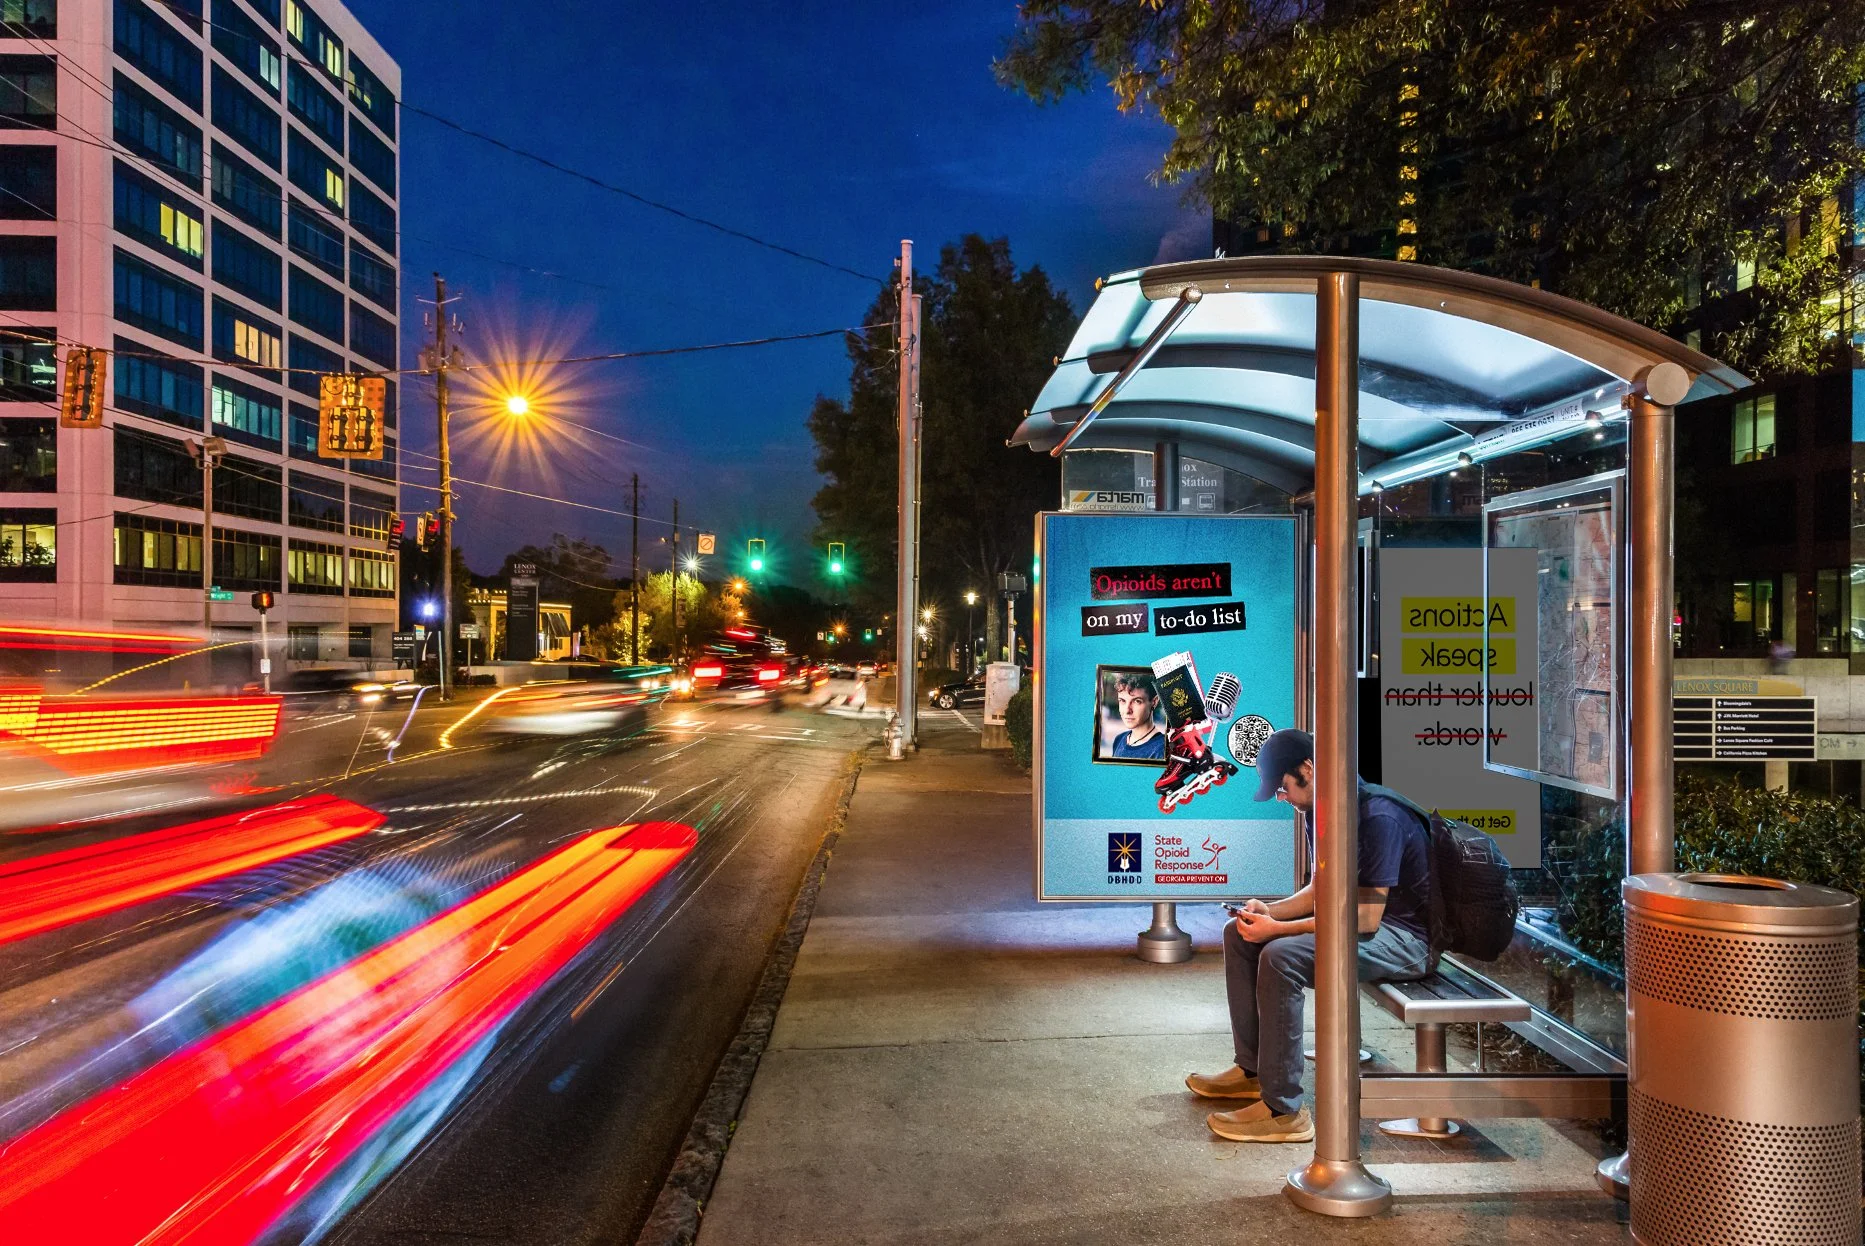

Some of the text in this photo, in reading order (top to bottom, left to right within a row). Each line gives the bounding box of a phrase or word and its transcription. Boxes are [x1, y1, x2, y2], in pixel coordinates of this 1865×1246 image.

[1181, 476, 1217, 487] Station
[1096, 571, 1222, 596] Opioids aren't
[1086, 607, 1242, 629] on my to-do list
[1676, 681, 1753, 693] LENOX SQUARE
[1154, 834, 1182, 845] State
[1154, 847, 1190, 859] Opioid
[1154, 859, 1204, 872] Response
[1107, 875, 1142, 884] DBHDD
[1157, 875, 1225, 883] GEORGIA PREVENTON
